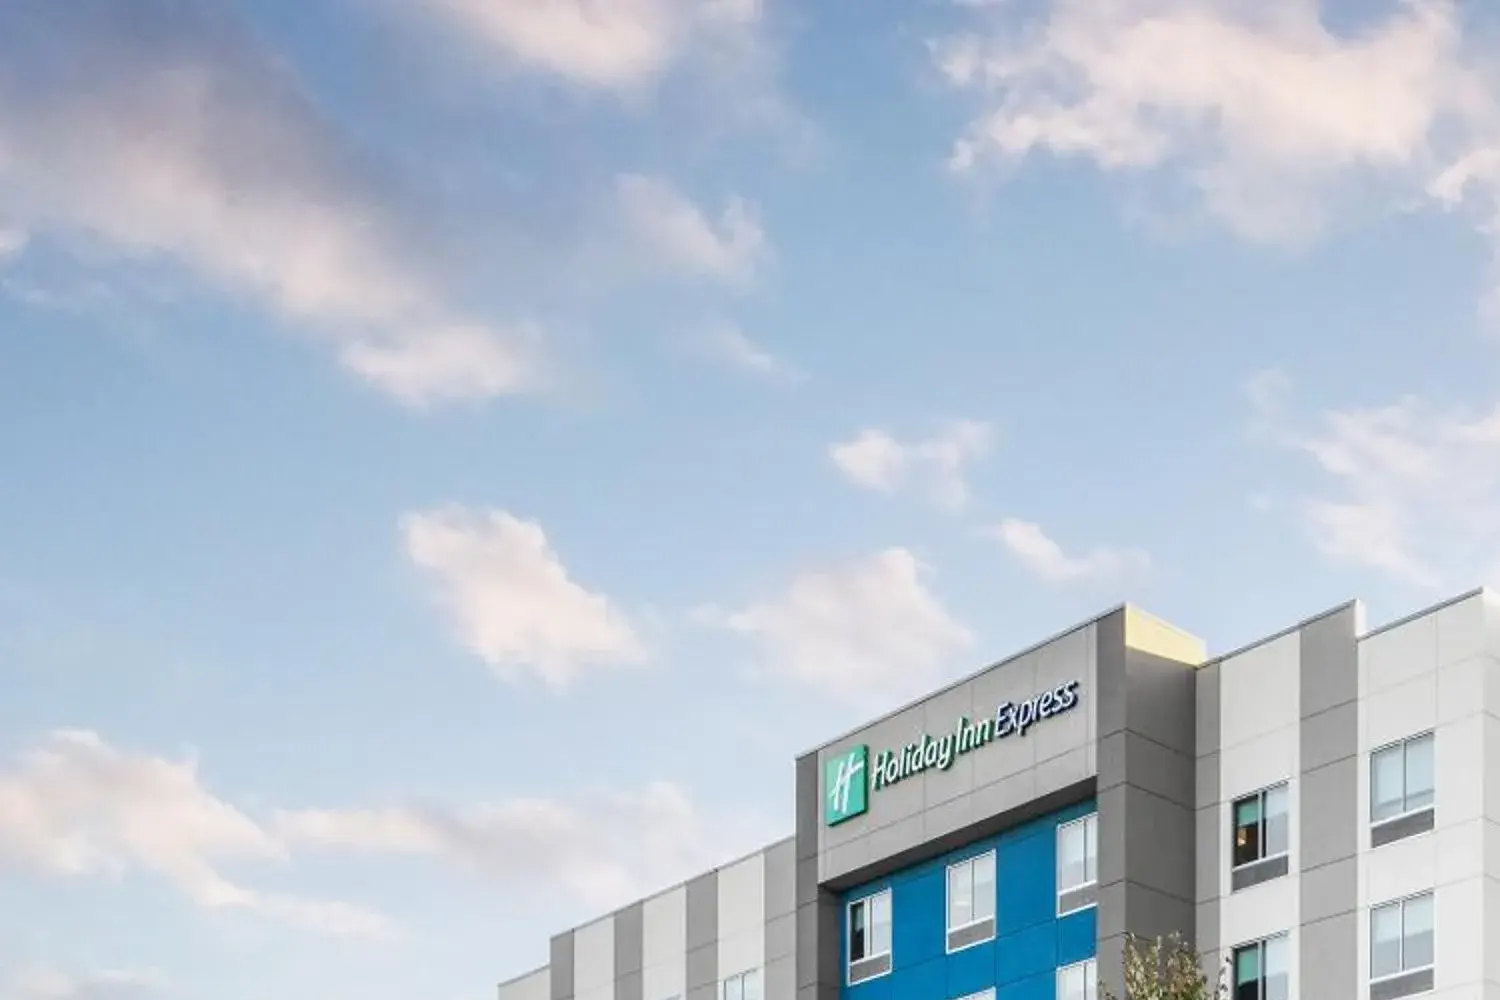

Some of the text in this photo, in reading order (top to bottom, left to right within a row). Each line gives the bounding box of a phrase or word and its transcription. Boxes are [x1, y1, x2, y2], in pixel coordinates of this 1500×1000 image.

[872, 681, 1078, 790] Holiday Inn Express
